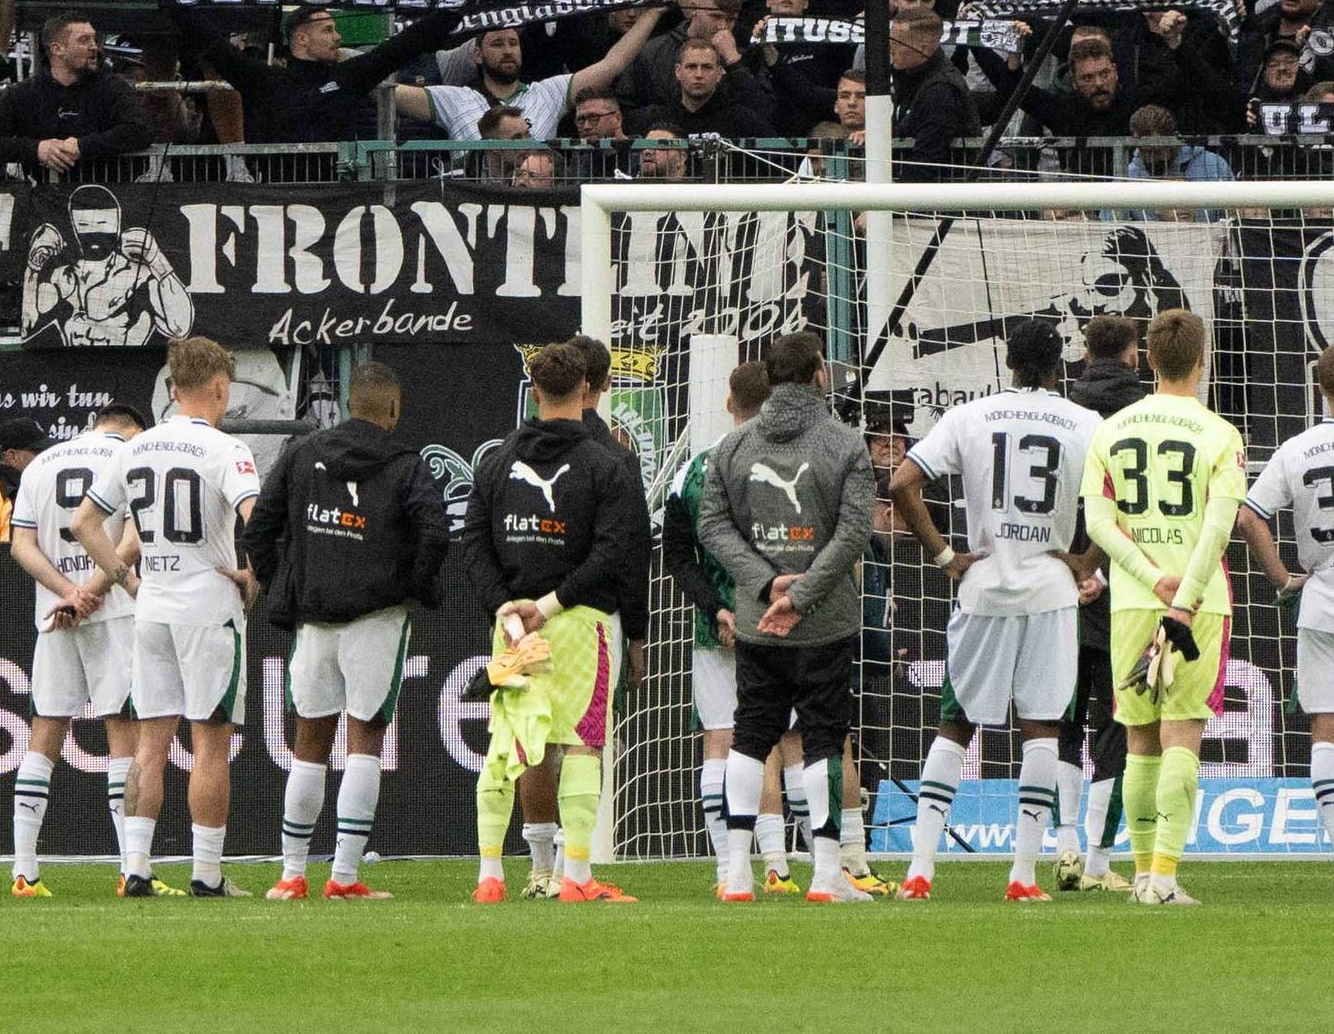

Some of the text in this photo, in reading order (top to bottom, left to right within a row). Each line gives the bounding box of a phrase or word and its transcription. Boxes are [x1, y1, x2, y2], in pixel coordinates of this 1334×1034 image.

[269, 301, 473, 345] Ackerbande
[22, 388, 64, 408] wir
[67, 384, 113, 408] tun
[992, 432, 1067, 514] 13
[1110, 438, 1198, 516] 33
[127, 468, 208, 544] 20
[995, 526, 1050, 543] JORDAN
[1131, 526, 1183, 545] NICOLAS
[145, 554, 181, 571] NETZ
